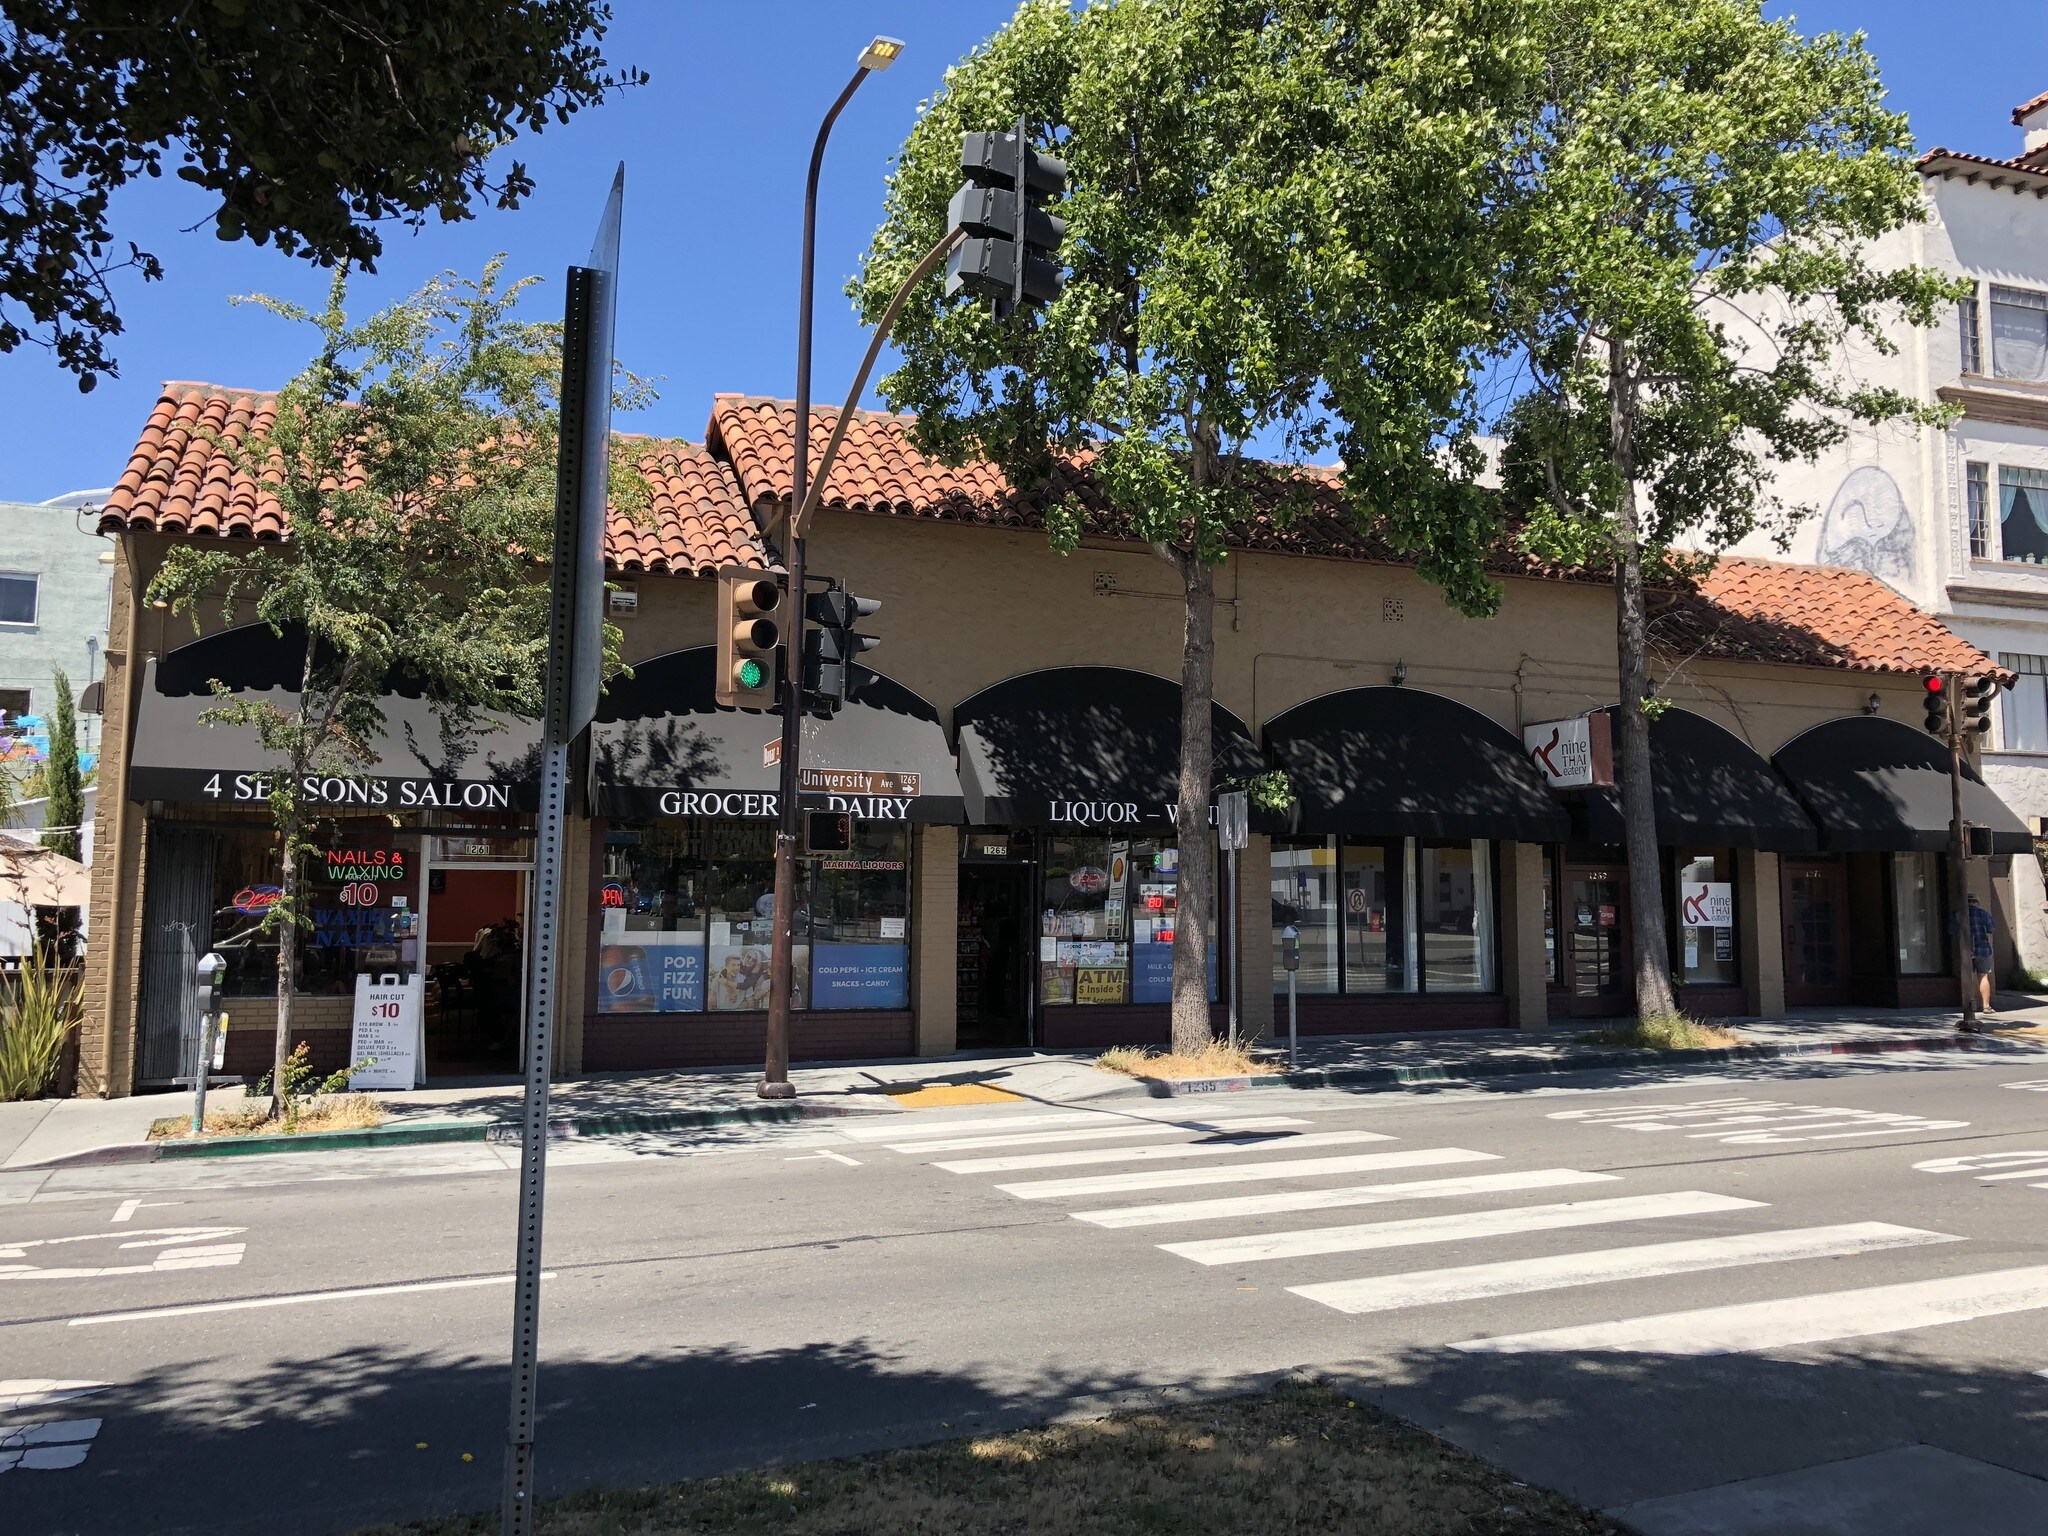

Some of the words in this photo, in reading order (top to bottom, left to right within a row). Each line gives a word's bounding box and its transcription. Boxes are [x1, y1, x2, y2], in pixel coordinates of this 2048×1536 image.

[1562, 740, 1586, 755] nine
[1562, 754, 1586, 767] THAI
[1564, 766, 1587, 777] eatery
[803, 770, 873, 792] University
[881, 779, 894, 788] Ave
[900, 774, 917, 785] 1265
[203, 773, 222, 798] 4
[234, 774, 388, 804] SESONS
[400, 781, 512, 808] SALON
[660, 792, 780, 816] GROCER
[828, 796, 914, 819] DAIRY
[1050, 801, 1141, 827] LIQUOR
[466, 845, 490, 854] 1261
[985, 846, 1006, 854] 1265
[328, 850, 386, 864] NAILS
[392, 852, 402, 864] &
[822, 860, 861, 870] MARINA
[862, 861, 904, 870] LIQUORS
[328, 866, 404, 880] WAXING
[340, 883, 378, 906] $10
[1710, 895, 1730, 906] nine
[1710, 906, 1730, 915] THAI
[664, 957, 698, 968] POP.
[664, 972, 700, 984] FIZZ.
[1079, 971, 1123, 984] ATM
[663, 988, 696, 1000] FUN.
[1088, 985, 1114, 994] Inside
